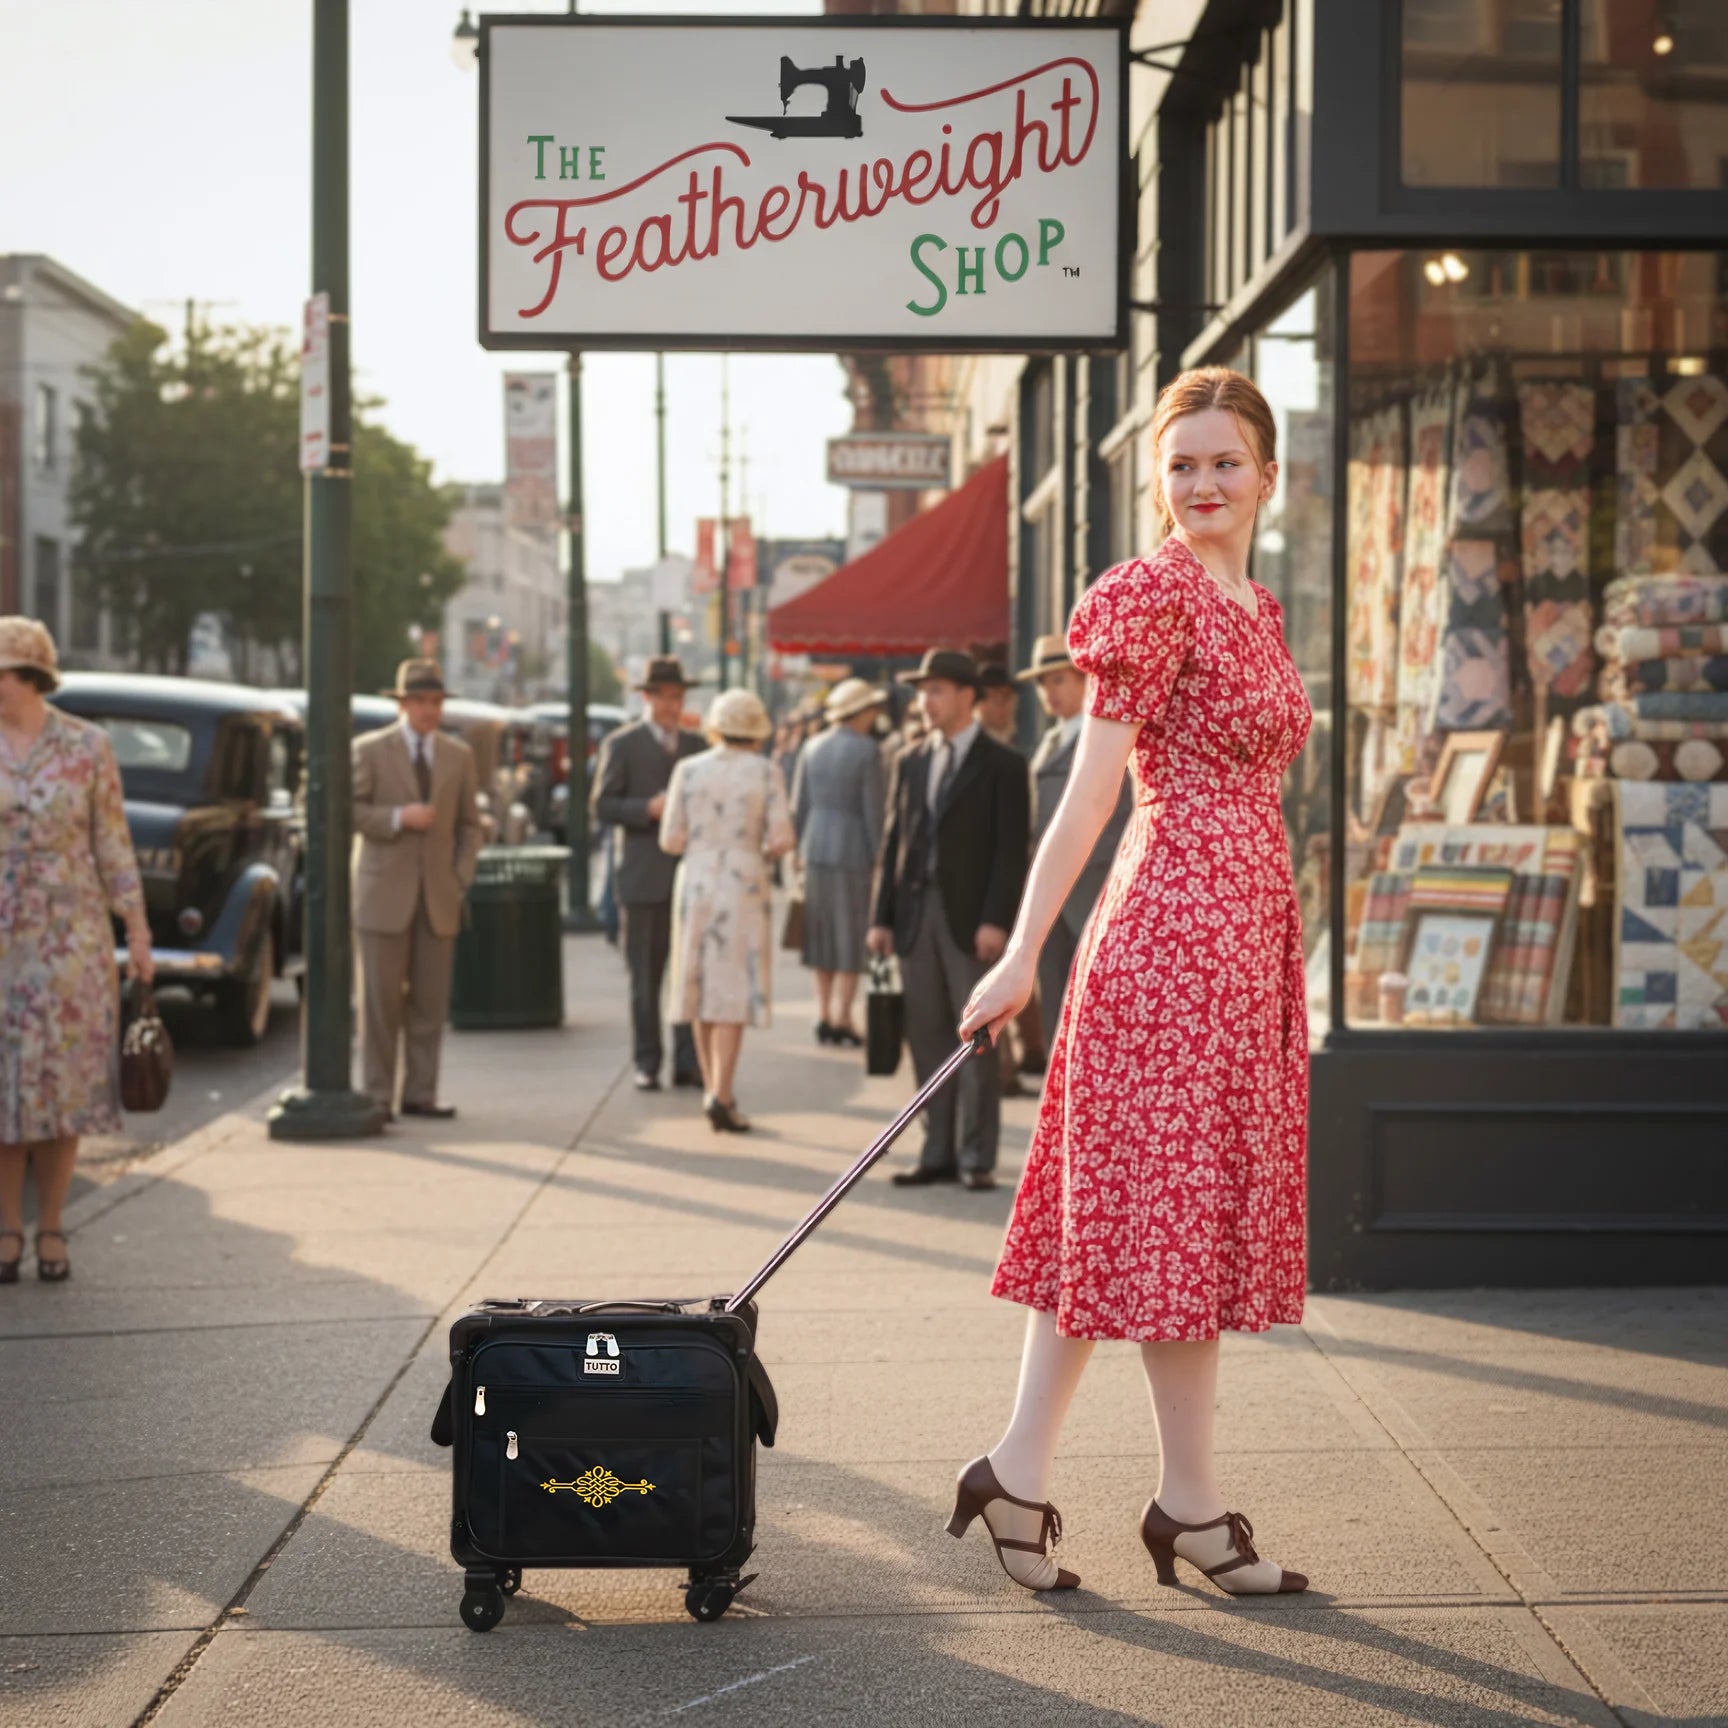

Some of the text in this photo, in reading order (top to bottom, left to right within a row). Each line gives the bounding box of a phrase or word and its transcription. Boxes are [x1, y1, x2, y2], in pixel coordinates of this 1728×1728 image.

[504, 56, 1100, 319] Featherweight
[526, 134, 607, 181] THE
[906, 218, 1066, 317] SHOP
[585, 1362, 618, 1371] TUTTO
